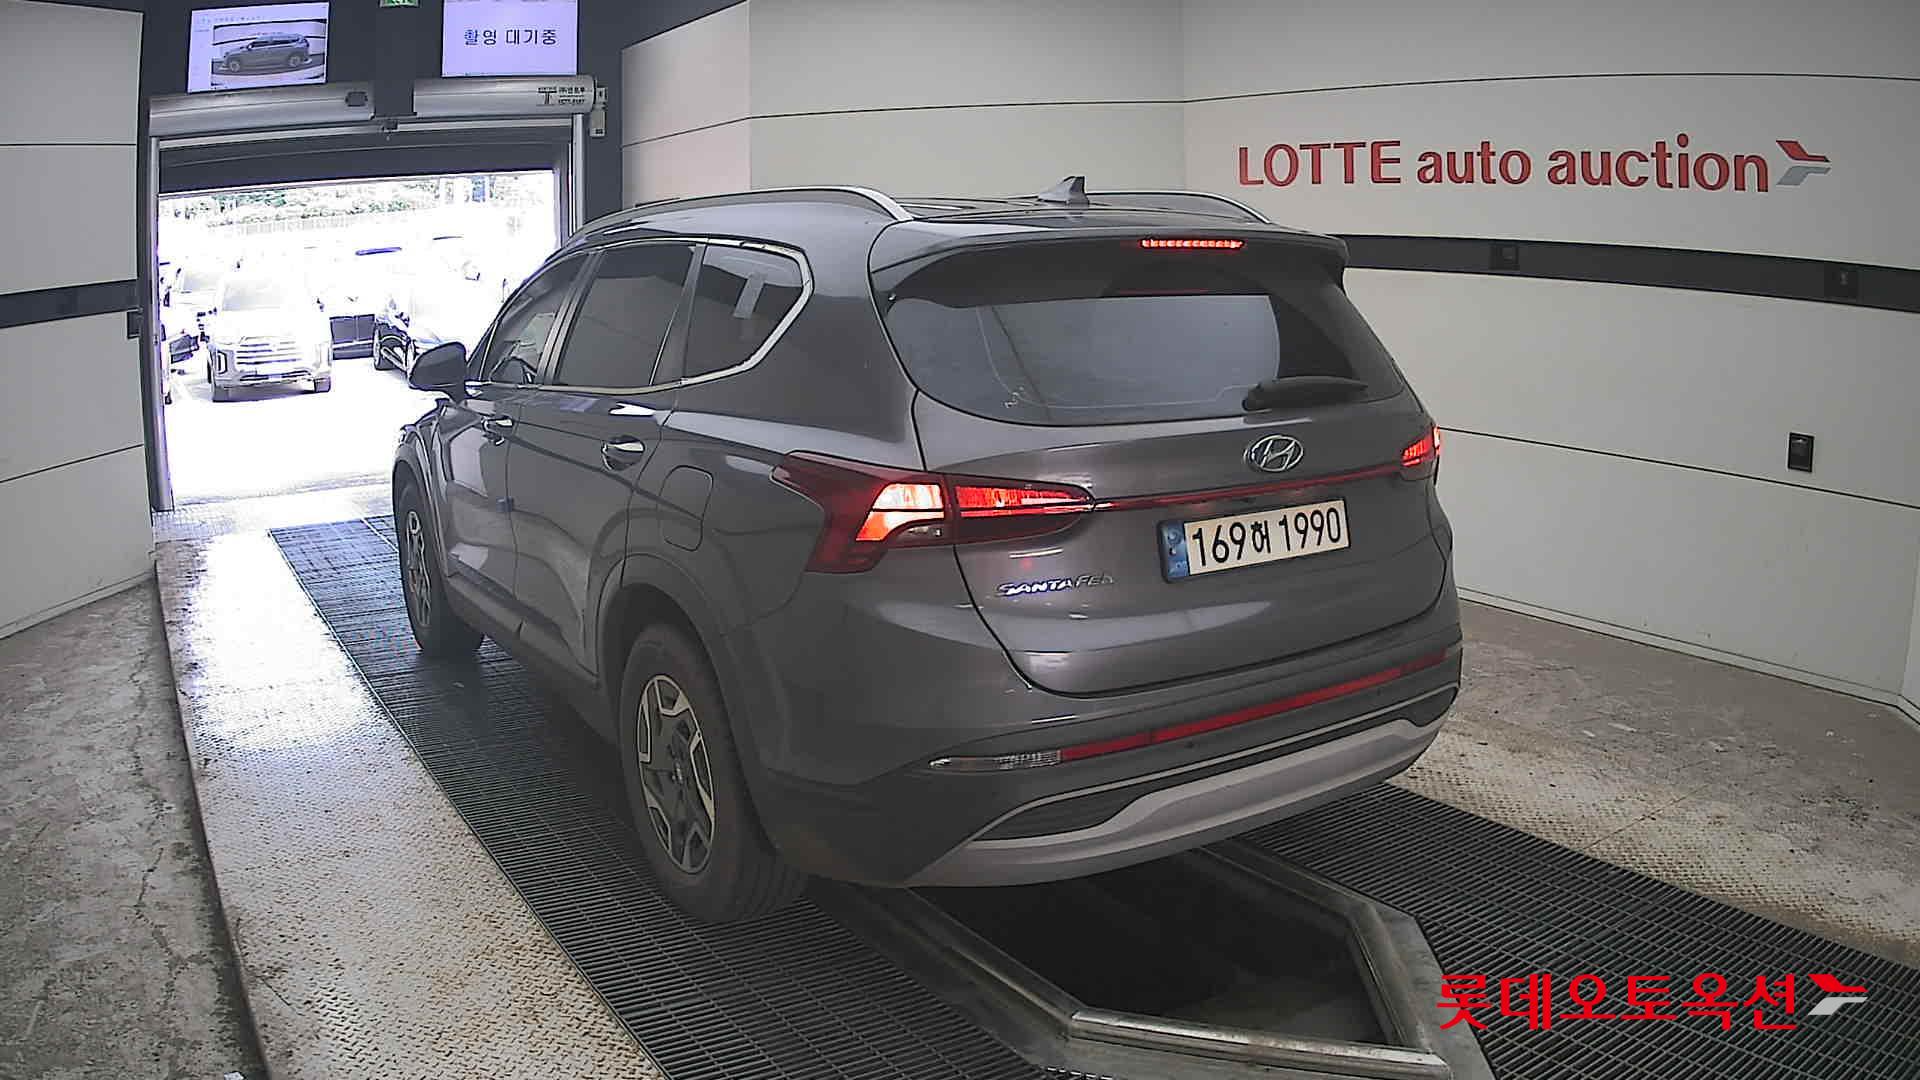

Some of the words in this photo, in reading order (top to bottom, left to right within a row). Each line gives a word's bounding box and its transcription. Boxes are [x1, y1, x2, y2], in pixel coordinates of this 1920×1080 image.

[506, 29, 556, 45] 대기중
[1239, 140, 1401, 187] LOTTE
[1417, 141, 1531, 185] auto
[1548, 133, 1768, 193] auction
[1192, 520, 1271, 567] 169허
[1279, 507, 1341, 551] 1990
